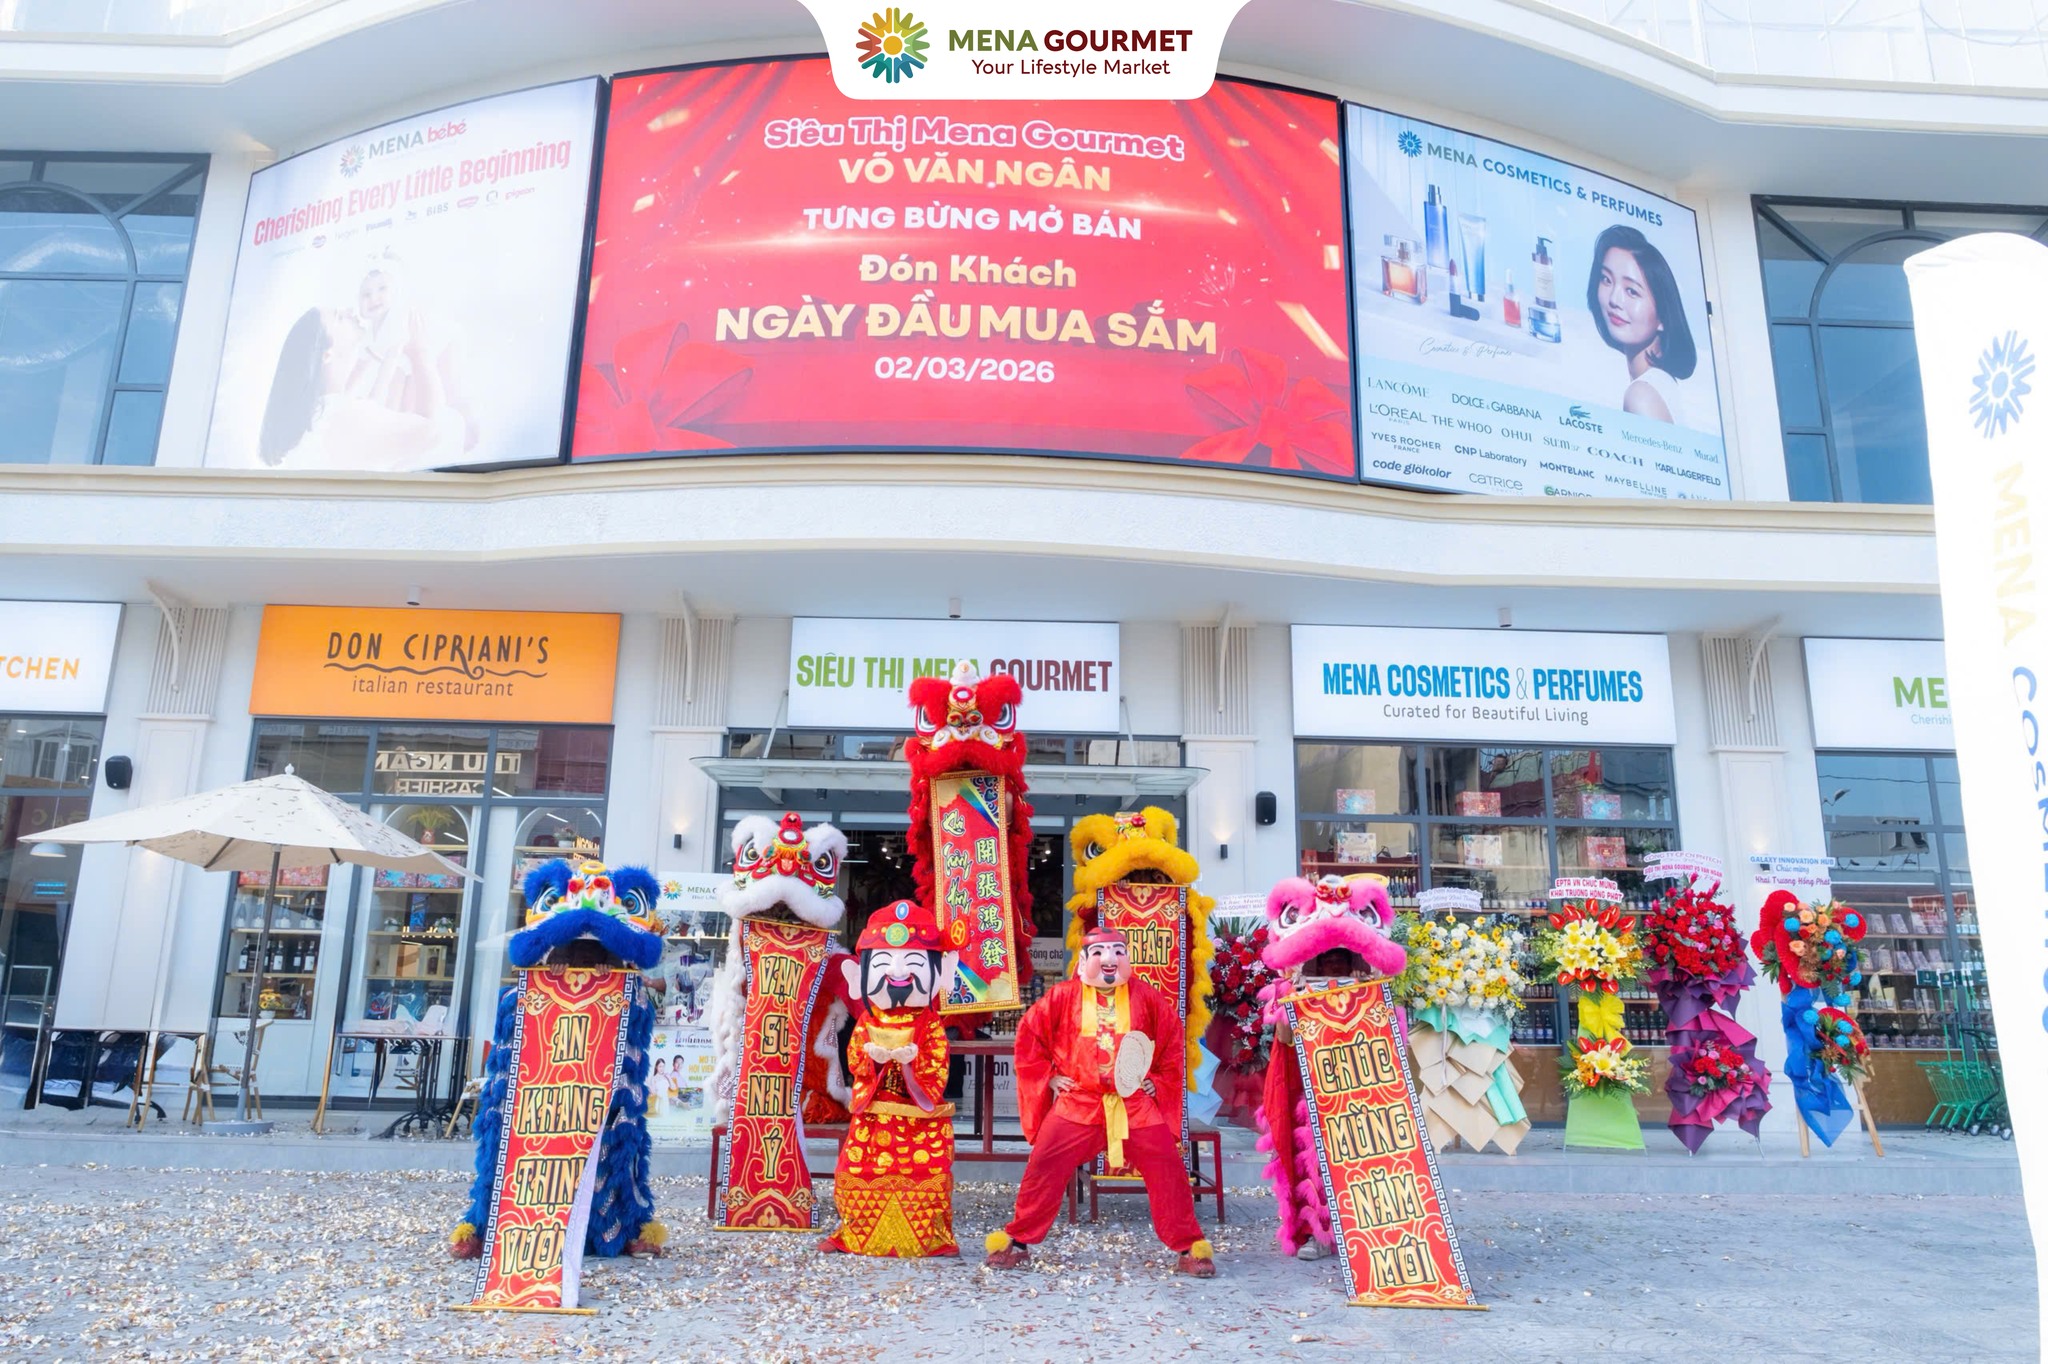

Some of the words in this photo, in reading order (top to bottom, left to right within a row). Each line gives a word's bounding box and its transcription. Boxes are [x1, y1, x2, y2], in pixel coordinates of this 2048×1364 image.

[368, 131, 424, 159] MENA
[427, 119, 467, 143] bébé
[763, 118, 844, 150] Siêu
[849, 116, 906, 153] Thị
[912, 116, 1016, 148] Mena
[1022, 120, 1185, 162] Gourmet
[839, 153, 894, 184] VÕ
[905, 156, 984, 185] VĂN
[995, 157, 1110, 192] NGÂN
[1427, 143, 1478, 168] MENA
[1483, 158, 1572, 196] COSMETICS
[1576, 187, 1588, 200] &
[1591, 190, 1663, 227] PERFUMES
[253, 197, 342, 246] Cherishing
[347, 179, 402, 217] Every
[404, 168, 454, 201] Little
[458, 140, 572, 188] Beginning
[803, 206, 895, 230] TƯNG
[905, 201, 1000, 231] BỪNG
[1009, 204, 1064, 234] MỞ
[1073, 208, 1142, 240] BÁN
[859, 253, 938, 283] Đón
[950, 254, 1077, 288] Khách
[715, 295, 855, 342] NGÀY
[866, 290, 971, 338] ĐẦU
[980, 305, 1095, 345] MUA
[1107, 300, 1218, 354] SẮM
[874, 356, 1055, 383] 02/03/2026
[1367, 377, 1430, 398] LANCÔME
[1451, 393, 1485, 409] DOLCE
[1491, 401, 1542, 420] GABBANA
[1432, 414, 1454, 428] THE
[1457, 419, 1493, 435] WHOO
[1501, 428, 1533, 443] OHUI
[1559, 416, 1604, 434] LACOSTE
[1371, 431, 1397, 443] YVES
[1400, 436, 1442, 451] ROCHER
[1393, 444, 1420, 454] FRANCE
[1454, 445, 1477, 456] CNP
[1479, 449, 1527, 467] Laboratory
[1587, 446, 1644, 467] COACH
[1621, 430, 1683, 454] Mercedes-Benz
[1372, 459, 1402, 471] code
[1539, 461, 1595, 479] MONTBLANC
[1655, 462, 1677, 476] KARL
[1677, 467, 1722, 486] LAGERFELD
[1604, 474, 1668, 496] MAYBELLINE
[327, 632, 382, 660] DON
[403, 633, 549, 667] CIPRIANI'S
[352, 675, 408, 694] italian
[416, 680, 514, 697] restaurant
[796, 652, 855, 688] SIÊU
[863, 656, 904, 693] THỊ
[912, 657, 980, 680] ME
[990, 659, 1113, 692] GOURMET
[1322, 663, 1382, 696] MENA
[1387, 664, 1510, 700] COSMETICS
[1515, 667, 1529, 701] &
[1533, 668, 1643, 702] PERFUMES
[1893, 676, 1948, 708] ME
[1383, 703, 1440, 719] Curated
[1445, 704, 1466, 720] for
[1472, 705, 1540, 722] Beautiful
[1545, 707, 1589, 726] Living
[1911, 713, 1952, 726] Cherishi
[1778, 857, 1819, 865] INNOVATION
[687, 886, 711, 894] MENA
[1118, 920, 1172, 965] HÁT
[760, 955, 803, 1004] VẠN
[553, 1015, 588, 1063] AN
[1315, 1032, 1396, 1094] CHÚC
[518, 1085, 604, 1135] KHANG
[1327, 1103, 1416, 1164] MỪNG
[763, 1127, 782, 1179] Ý
[1350, 1168, 1425, 1229] NĂM
[1371, 1234, 1437, 1288] MỚI
